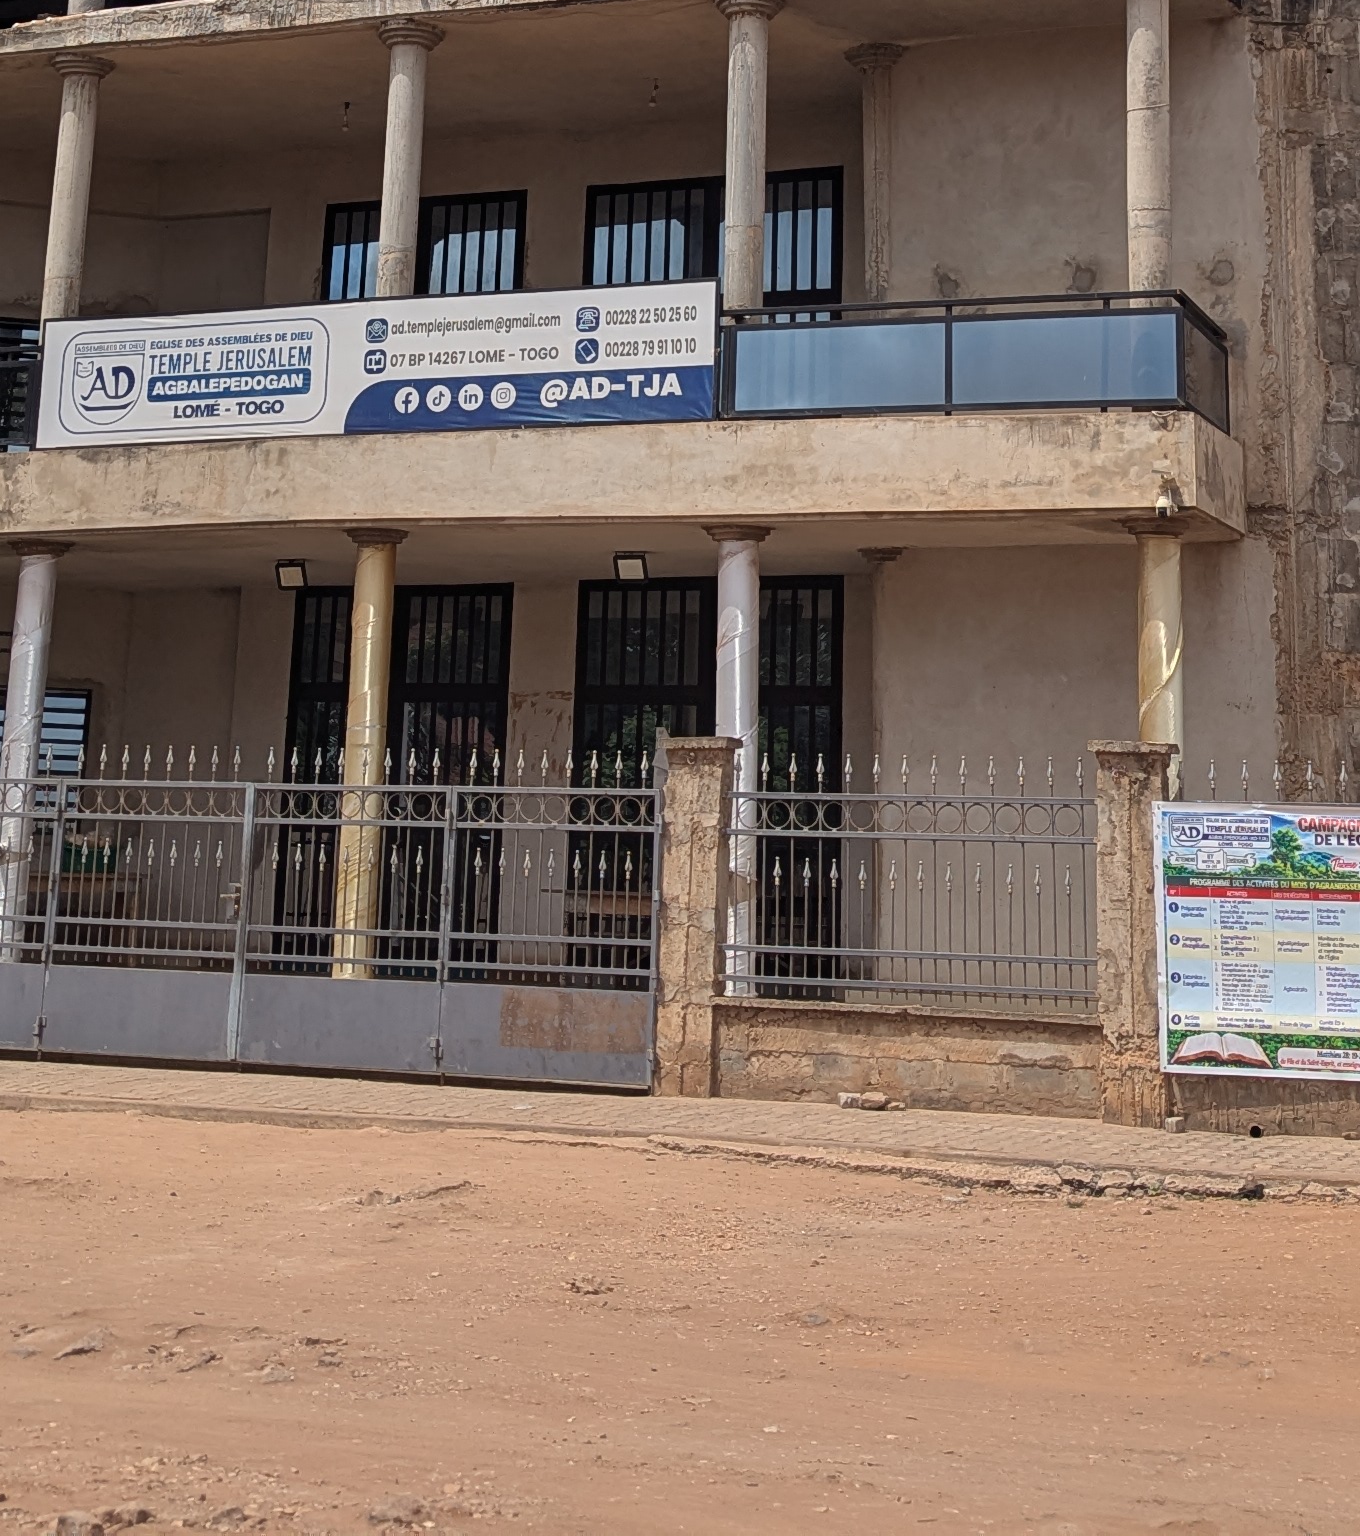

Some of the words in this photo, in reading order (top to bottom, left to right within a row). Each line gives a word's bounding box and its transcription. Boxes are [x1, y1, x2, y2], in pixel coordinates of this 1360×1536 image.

[391, 312, 561, 337] ad.templejerusalem@gmail.com
[605, 309, 637, 326] 00228
[639, 308, 651, 324] 22
[653, 307, 666, 323] 50
[668, 307, 681, 322] 25
[683, 305, 697, 322] 60
[150, 340, 183, 350] EGLISE
[186, 338, 204, 348] DES
[207, 333, 272, 347] ASSEMBLÉES
[275, 333, 288, 343] DE
[290, 331, 313, 341] DIEU
[604, 341, 640, 358] 00228
[641, 340, 655, 356] 79
[657, 339, 669, 355] 91
[671, 339, 683, 354] 10
[684, 338, 696, 354] 10
[149, 351, 212, 375] TEMPLE
[216, 345, 312, 371] JERUSALEM
[390, 353, 406, 368] 07
[409, 353, 425, 366] BP
[428, 350, 466, 366] 14267
[468, 349, 506, 364] LOME
[519, 346, 559, 362] TOGO
[80, 366, 136, 401] AD
[152, 374, 303, 396] AGBALEPEDOGAN
[539, 372, 683, 407] @AD-TJA
[173, 400, 220, 419] LOMÉ
[236, 400, 284, 415] TOGO
[1176, 826, 1200, 839] AD
[1206, 825, 1232, 833] TEMPLE
[1314, 834, 1333, 846] DE
[1190, 879, 1231, 887] PROGRAMME
[1233, 879, 1244, 887] DES
[1246, 879, 1279, 888] ACTIVITÉS
[1280, 881, 1290, 889] DU
[1291, 881, 1308, 889] MOIS
[1172, 936, 1178, 944] 2
